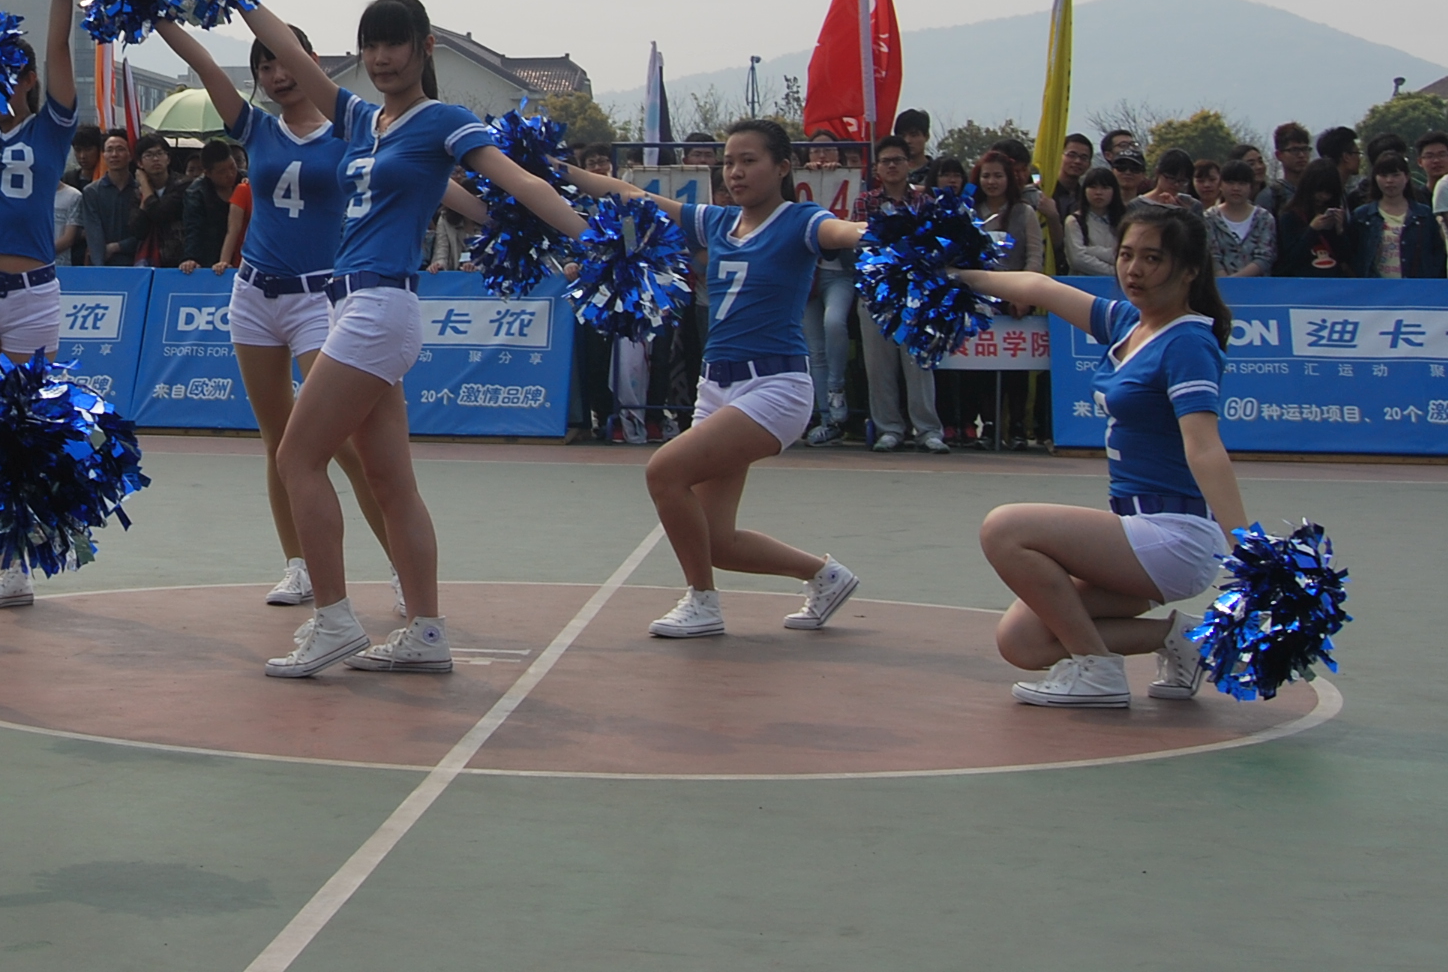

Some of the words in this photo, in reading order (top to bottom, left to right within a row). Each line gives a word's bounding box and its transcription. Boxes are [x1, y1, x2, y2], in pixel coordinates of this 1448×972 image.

[273, 161, 304, 218] 4
[346, 157, 375, 218] 3
[715, 260, 749, 321] 7
[163, 346, 205, 357] SPORTS
[206, 347, 228, 357] FOR
[1306, 318, 1448, 349] 迪卡
[1239, 363, 1289, 375] SPORTS
